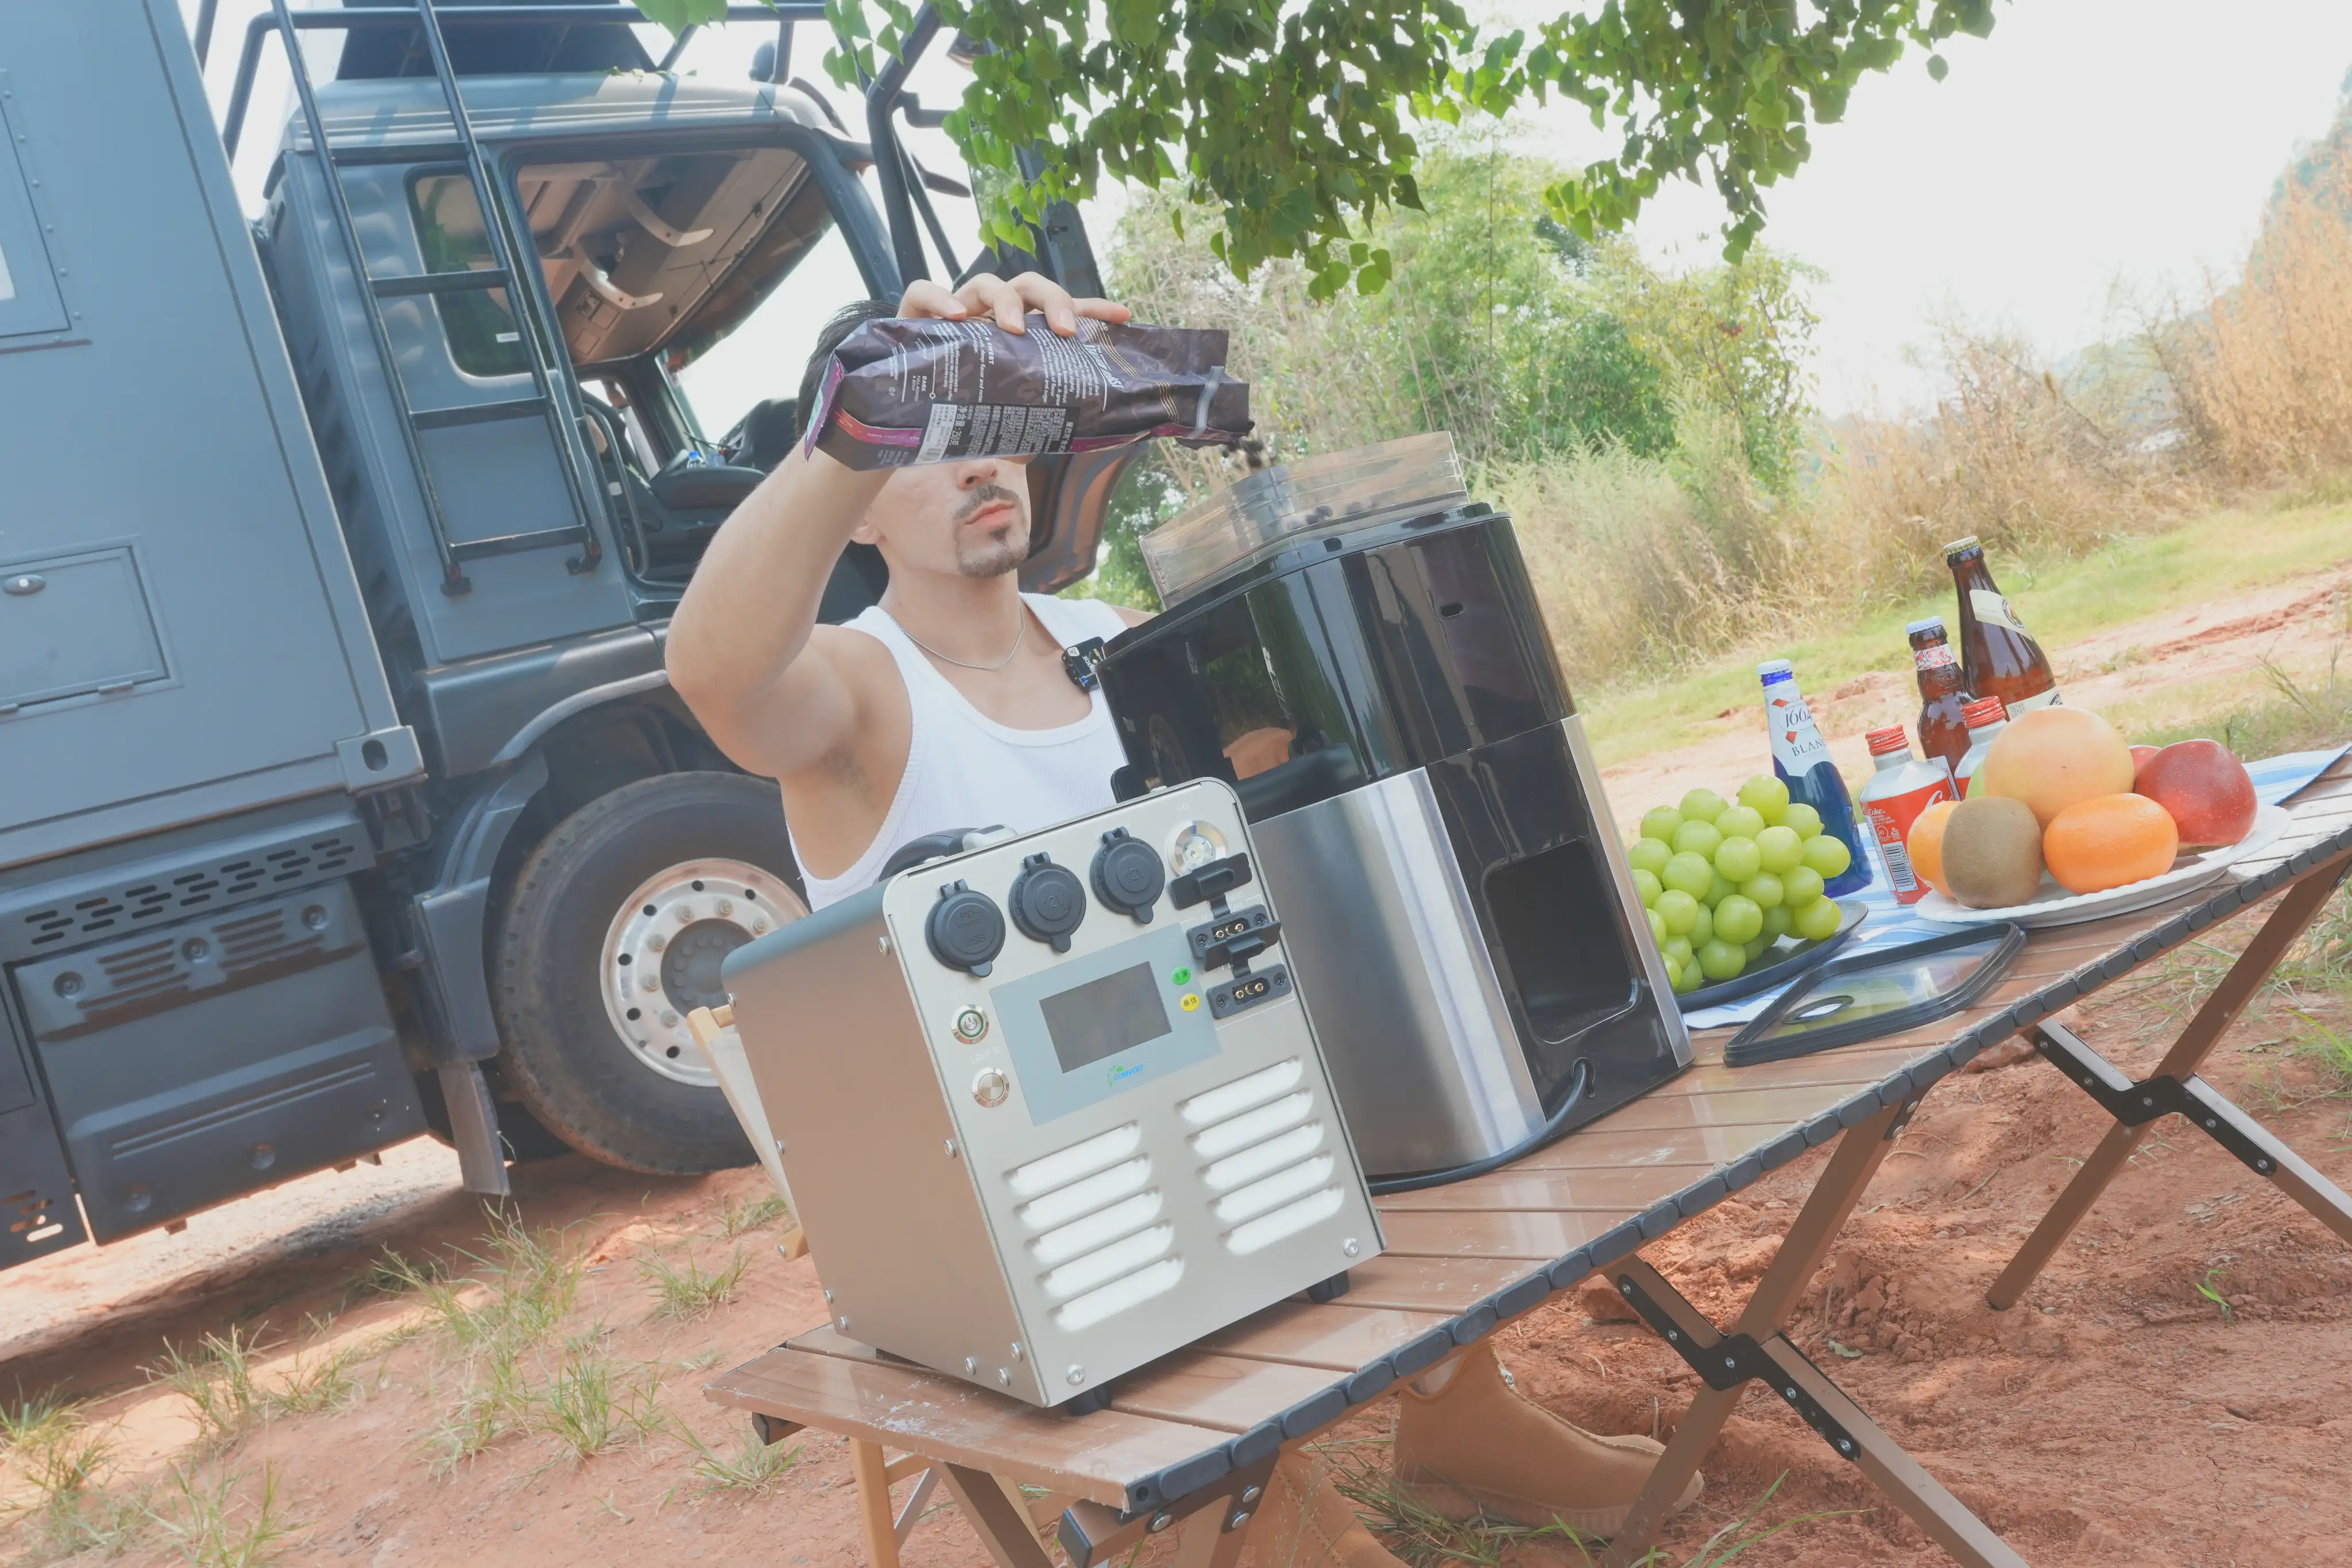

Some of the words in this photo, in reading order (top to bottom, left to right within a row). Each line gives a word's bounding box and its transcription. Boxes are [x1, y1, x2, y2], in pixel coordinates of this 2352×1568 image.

[1785, 706, 1812, 728] 1664
[1175, 969, 1189, 981] 主屏
[1183, 996, 1197, 1007] 单体
[1113, 1064, 1143, 1081] COMVOLT
